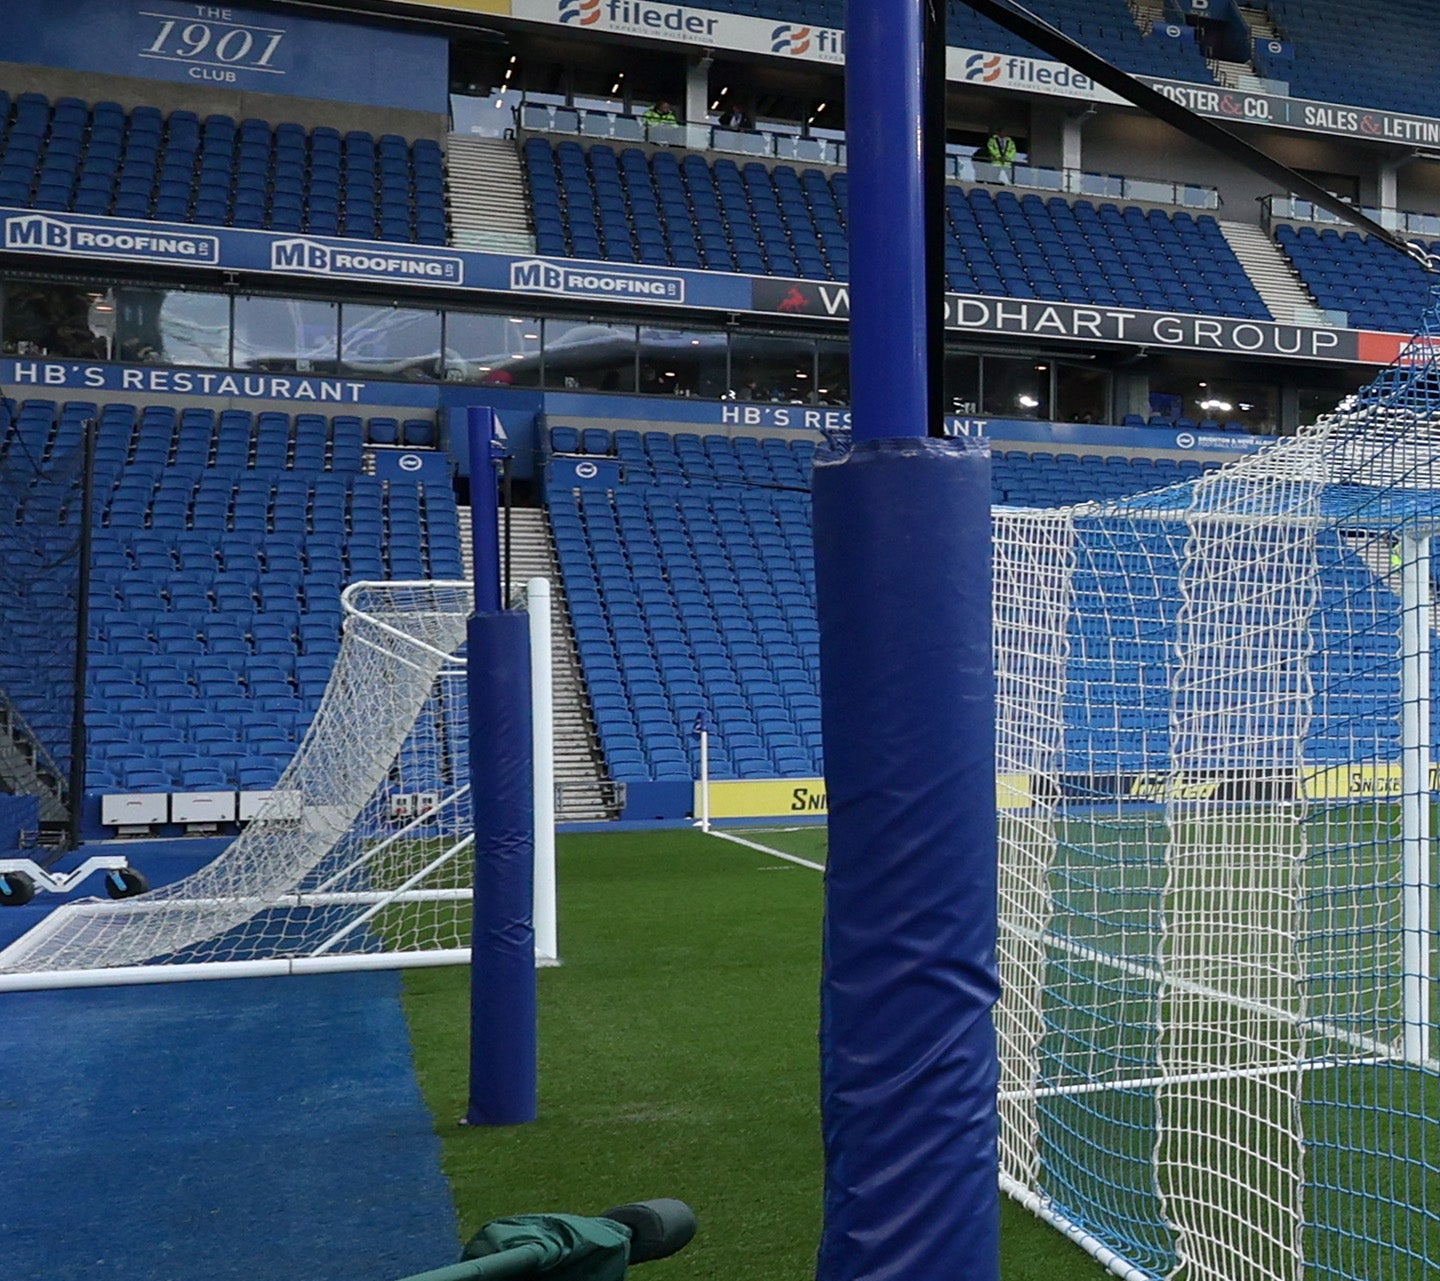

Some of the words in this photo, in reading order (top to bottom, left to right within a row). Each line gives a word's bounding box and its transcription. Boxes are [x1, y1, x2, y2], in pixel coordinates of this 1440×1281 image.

[195, 5, 233, 21] THE
[606, 0, 719, 36] fileder
[142, 20, 286, 67] 1901
[188, 67, 237, 83] CLUB
[1304, 106, 1358, 132] SALES
[1360, 114, 1382, 135] &
[7, 220, 69, 249] MB
[76, 231, 197, 256] ROOFING
[274, 243, 330, 272] MB
[335, 253, 443, 277] ROOFING
[513, 266, 562, 290] MB
[567, 275, 666, 296] ROOFING
[1152, 316, 1340, 356] GROUP
[13, 361, 106, 387] HB'S
[122, 369, 367, 403] RESTAURANT
[721, 404, 790, 427] HB'S
